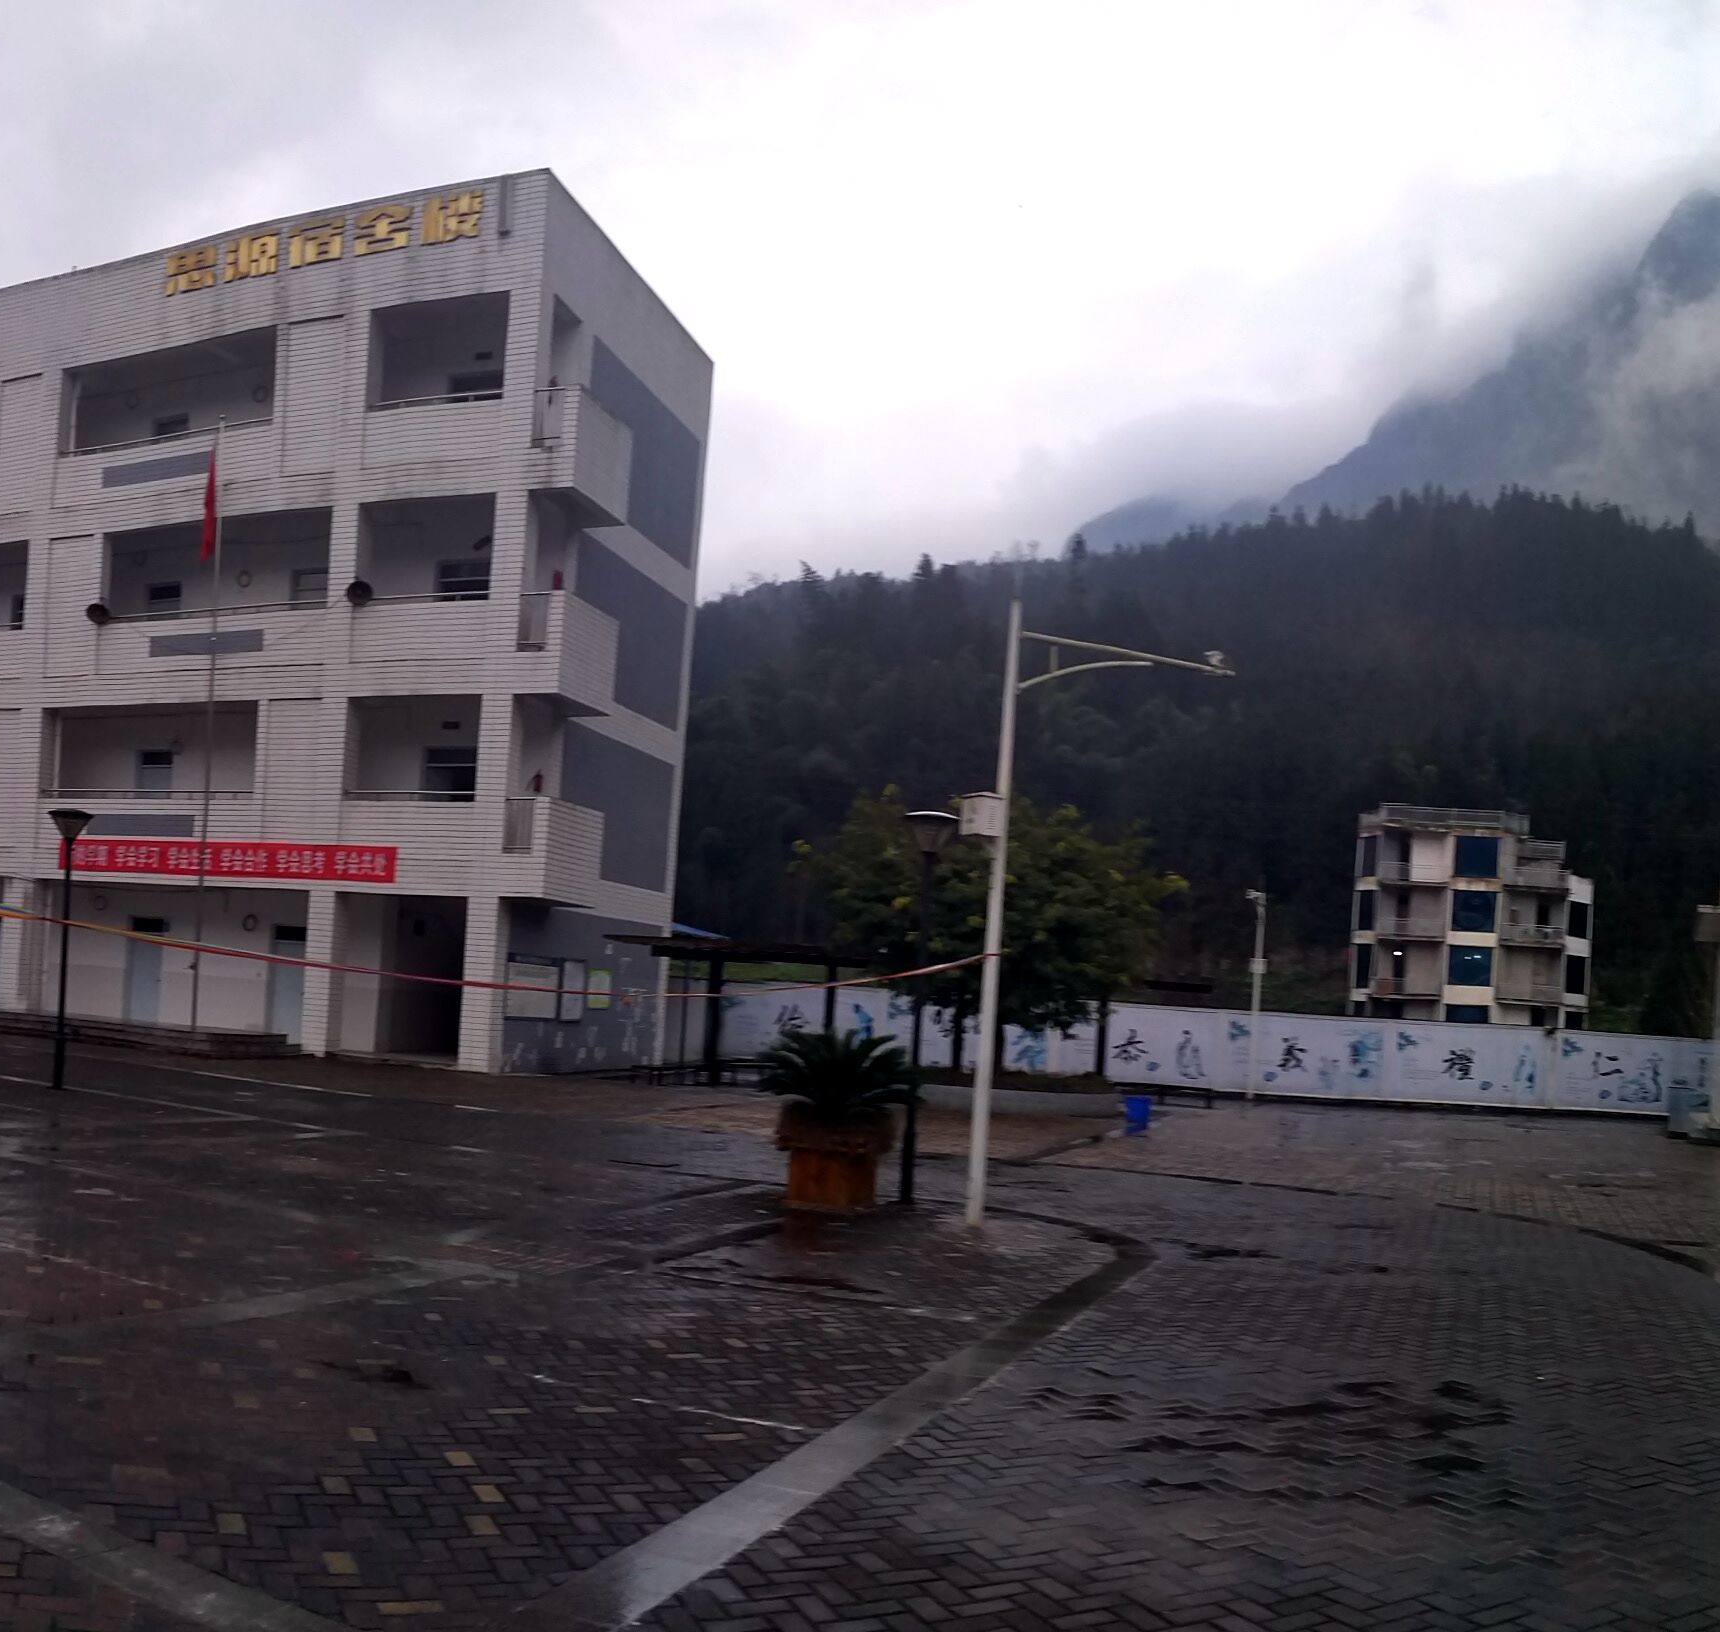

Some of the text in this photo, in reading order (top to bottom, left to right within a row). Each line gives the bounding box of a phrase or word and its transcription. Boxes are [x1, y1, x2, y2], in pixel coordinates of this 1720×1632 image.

[165, 190, 484, 297] 思源宿舍楼
[114, 844, 161, 869] 学会学习
[165, 846, 214, 870] 学会生活
[219, 848, 269, 872] 学会合作
[275, 850, 327, 874] 学会思考
[1591, 1050, 1624, 1081] 仁
